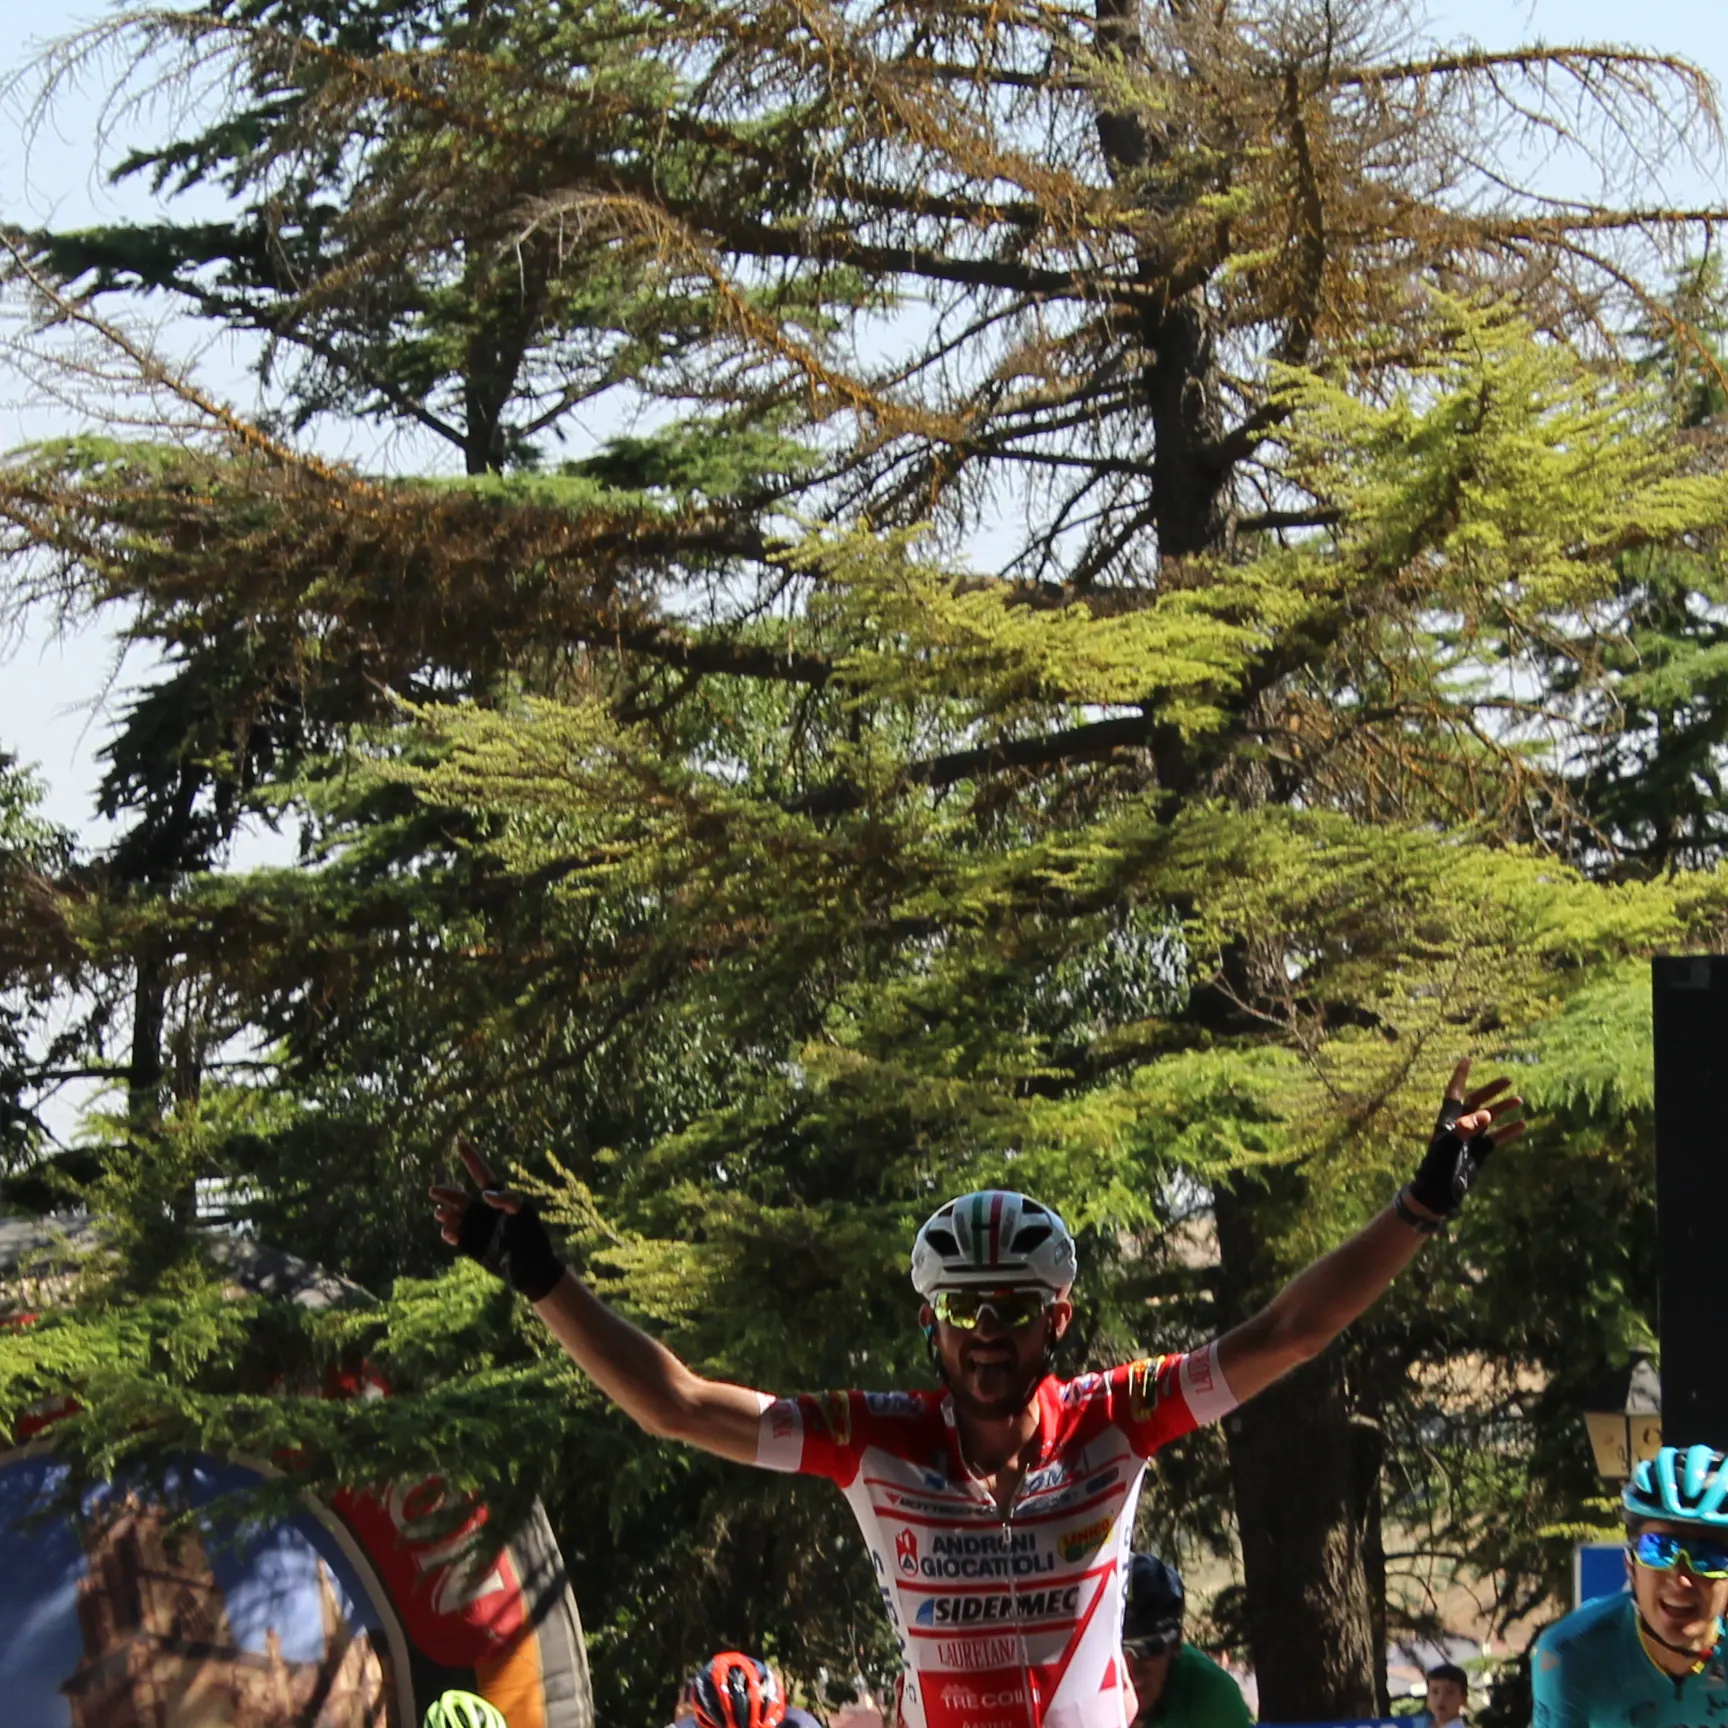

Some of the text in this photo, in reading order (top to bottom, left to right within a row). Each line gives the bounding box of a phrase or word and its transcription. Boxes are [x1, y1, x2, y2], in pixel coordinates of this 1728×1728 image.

[931, 1532, 1036, 1553] ANDRONI
[920, 1553, 1055, 1578] GIOCATTOLI
[934, 1586, 1080, 1621] SIDERMEC
